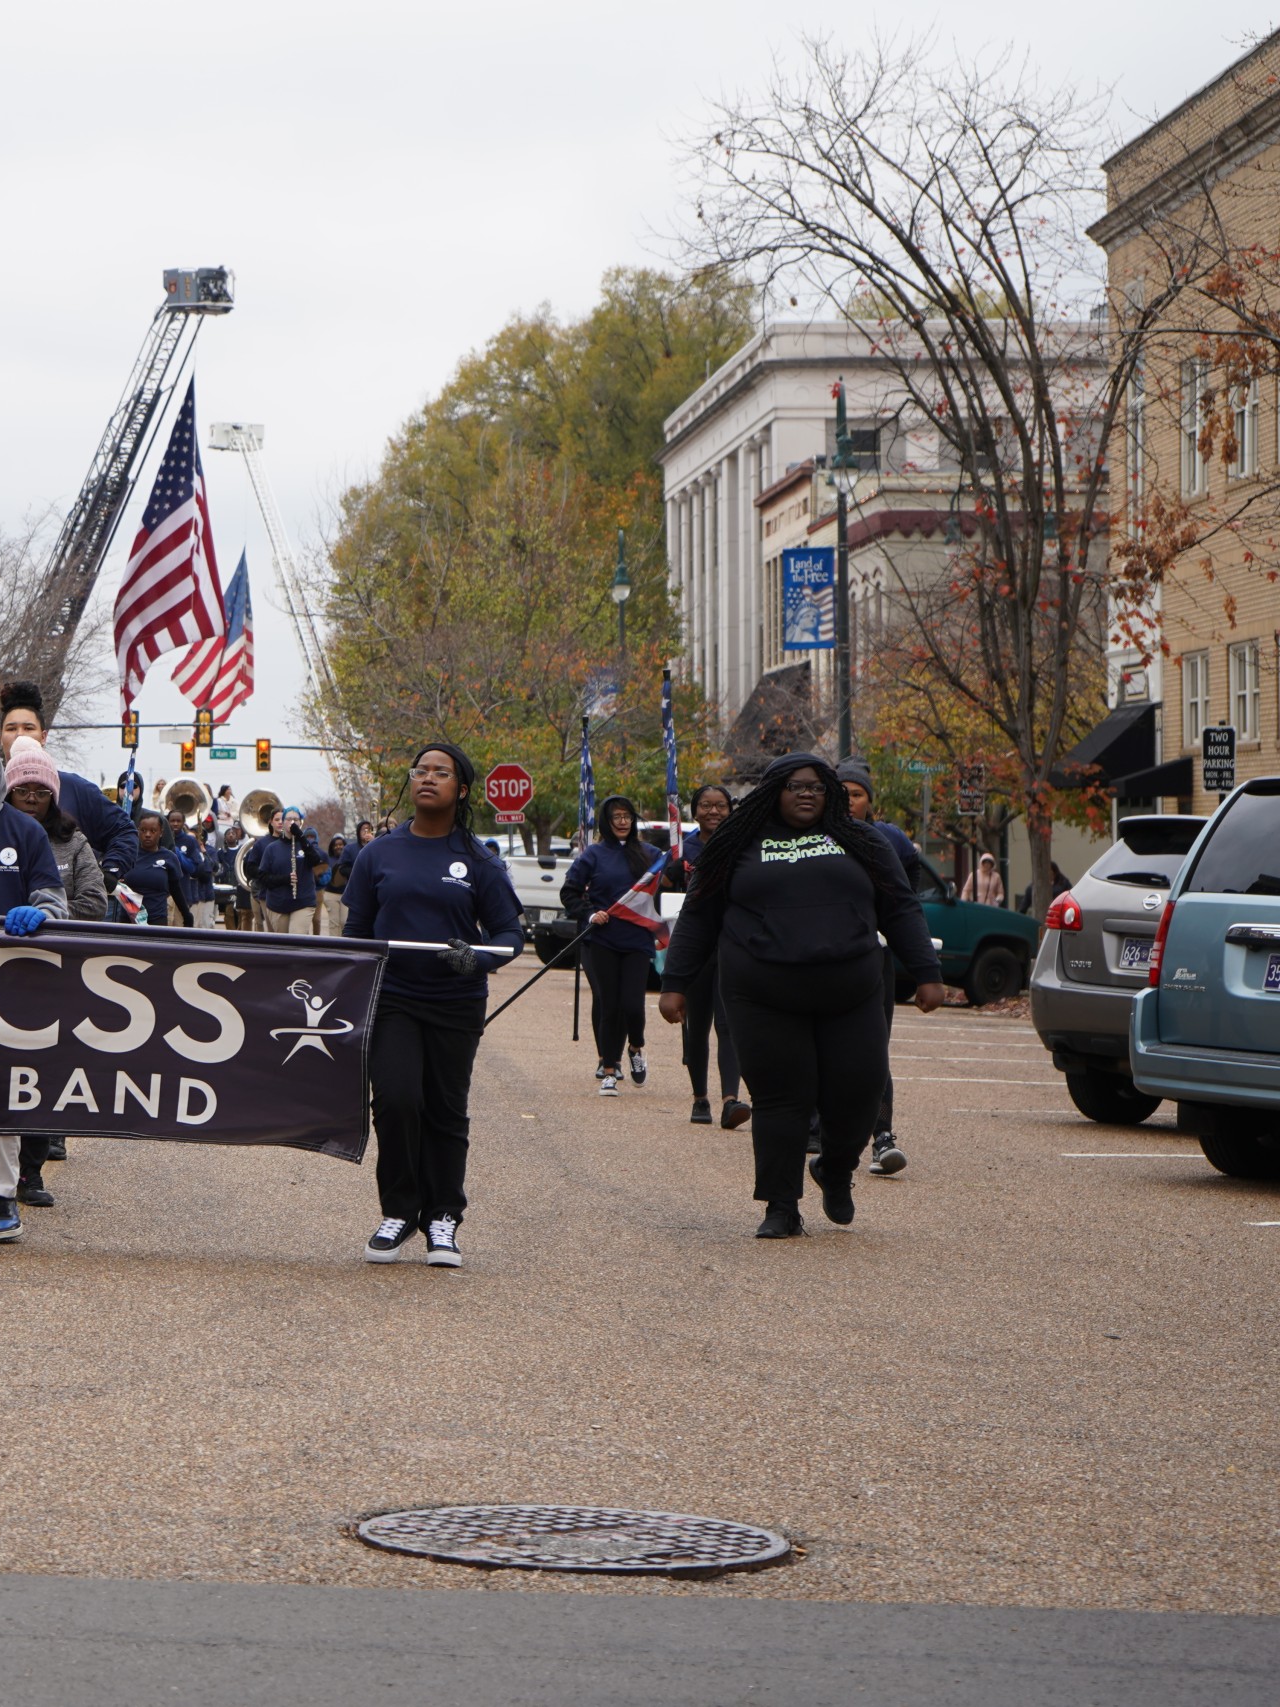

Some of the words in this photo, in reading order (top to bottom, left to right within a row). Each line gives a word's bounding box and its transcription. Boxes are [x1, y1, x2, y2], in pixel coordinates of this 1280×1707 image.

[789, 555, 813, 574] Land
[813, 558, 824, 571] of
[792, 570, 805, 582] the
[804, 569, 829, 585] Free
[1210, 732, 1229, 742] TWO
[1207, 745, 1230, 756] HOUR
[1203, 758, 1235, 769] PARKING
[489, 779, 529, 797] STOP
[761, 843, 846, 863] Imagination
[1123, 945, 1141, 961] 626
[8, 1066, 218, 1125] BAND
